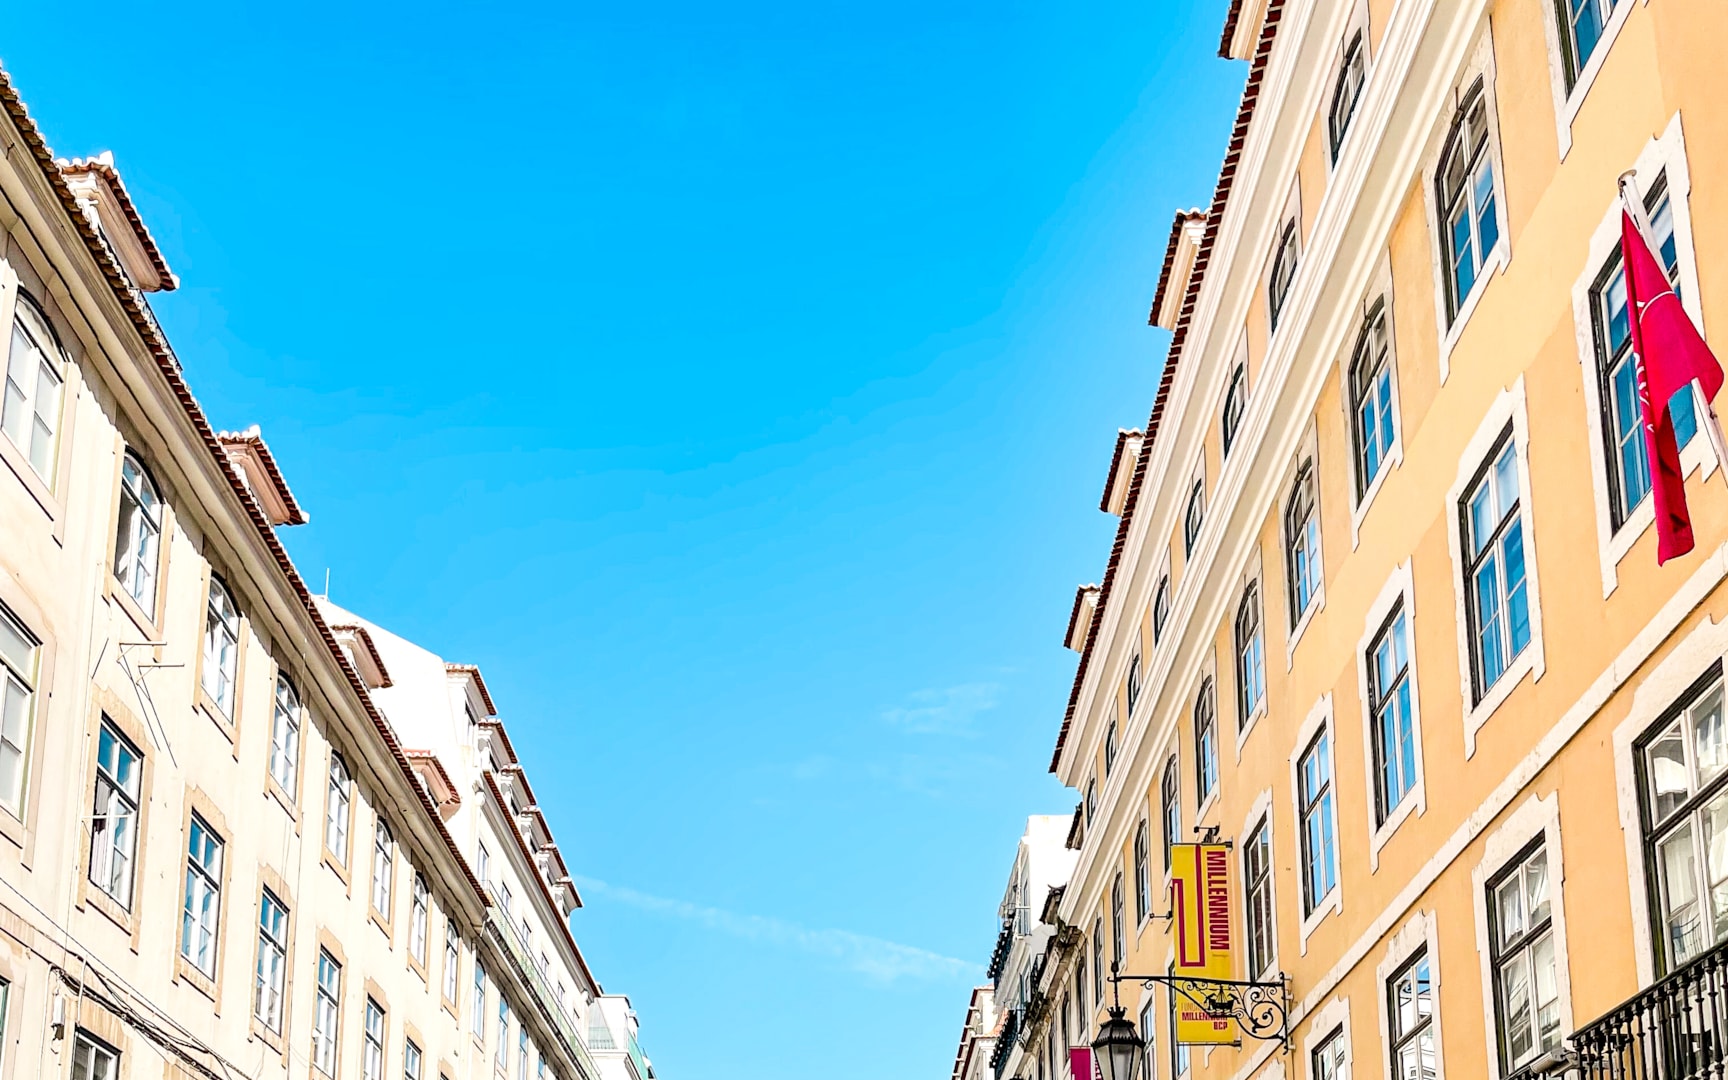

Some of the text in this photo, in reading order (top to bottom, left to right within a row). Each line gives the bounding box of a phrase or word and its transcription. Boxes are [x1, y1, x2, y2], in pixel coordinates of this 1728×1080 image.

[1206, 850, 1230, 950] MILLENNIUM
[1182, 1011, 1227, 1021] MILLEN
[1213, 1021, 1228, 1030] BCP
